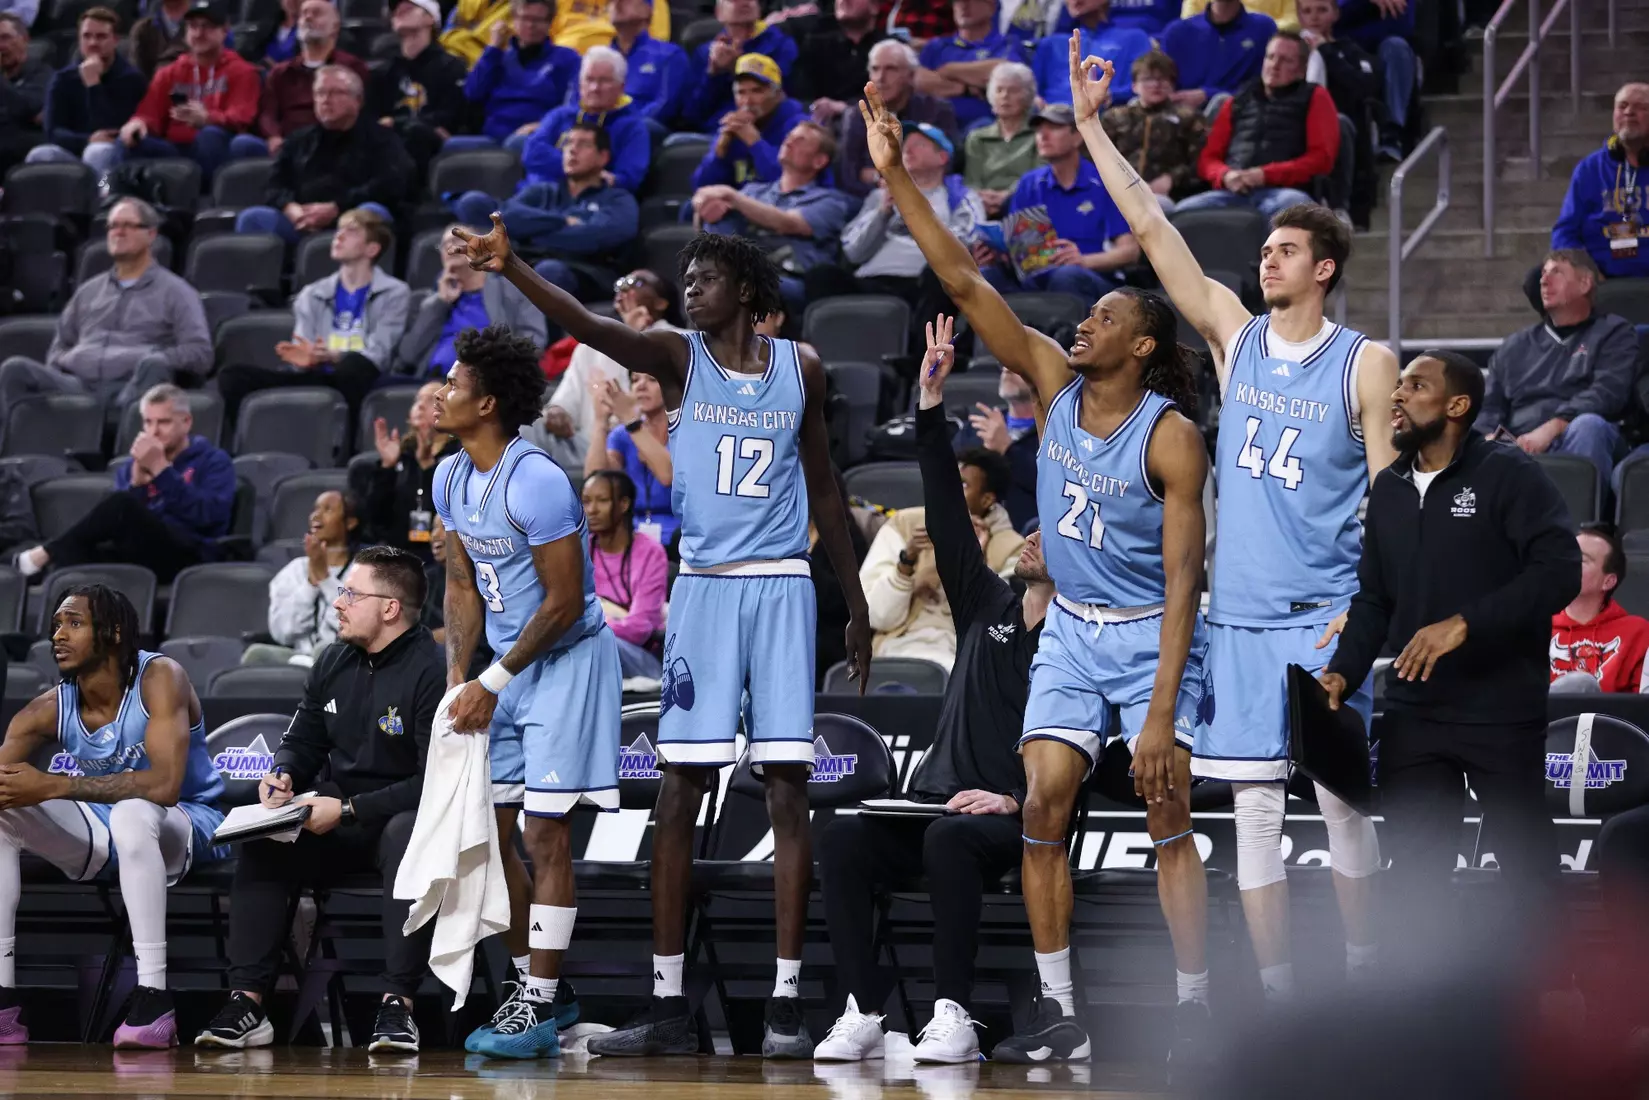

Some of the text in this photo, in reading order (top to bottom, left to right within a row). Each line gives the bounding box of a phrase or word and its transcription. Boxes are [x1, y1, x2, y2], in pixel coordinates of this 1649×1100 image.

[1235, 382, 1331, 423] KNSAS CITY
[693, 401, 797, 430] KANSAS CITY
[1236, 415, 1304, 491] 44
[715, 434, 774, 499] 12
[1091, 473, 1129, 498] CITY
[1057, 479, 1106, 551] 21
[1450, 506, 1476, 514] ROOS
[486, 536, 515, 556] CITY
[476, 561, 505, 613] 3
[125, 741, 147, 759] CIT
[215, 755, 275, 771] SUMM
[814, 757, 856, 773] MIT
[1546, 762, 1624, 779] UMIT
[1556, 780, 1605, 788] LEUE
